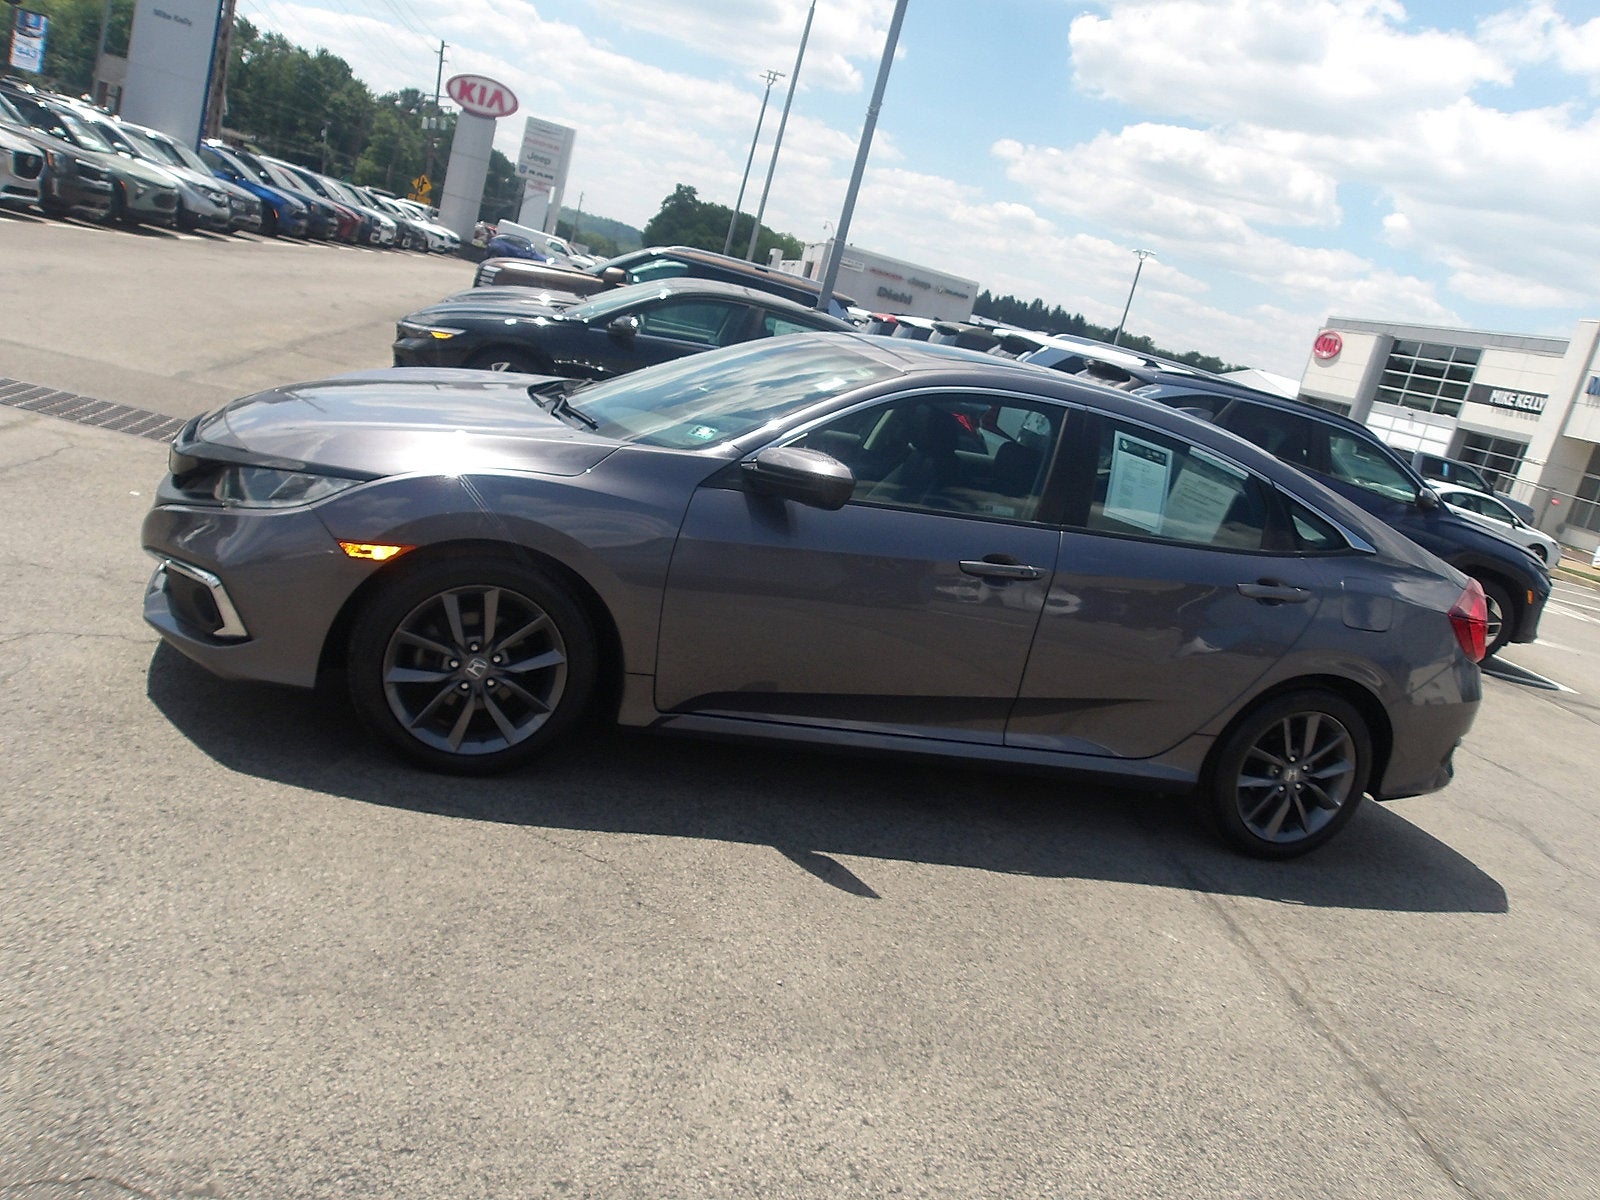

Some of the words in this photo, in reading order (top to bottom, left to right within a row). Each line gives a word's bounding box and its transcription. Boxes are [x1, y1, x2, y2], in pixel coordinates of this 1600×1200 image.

[458, 79, 504, 112] KIA
[527, 152, 551, 165] Jeep
[1489, 389, 1516, 405] MIKE
[1515, 394, 1547, 411] KELLY
